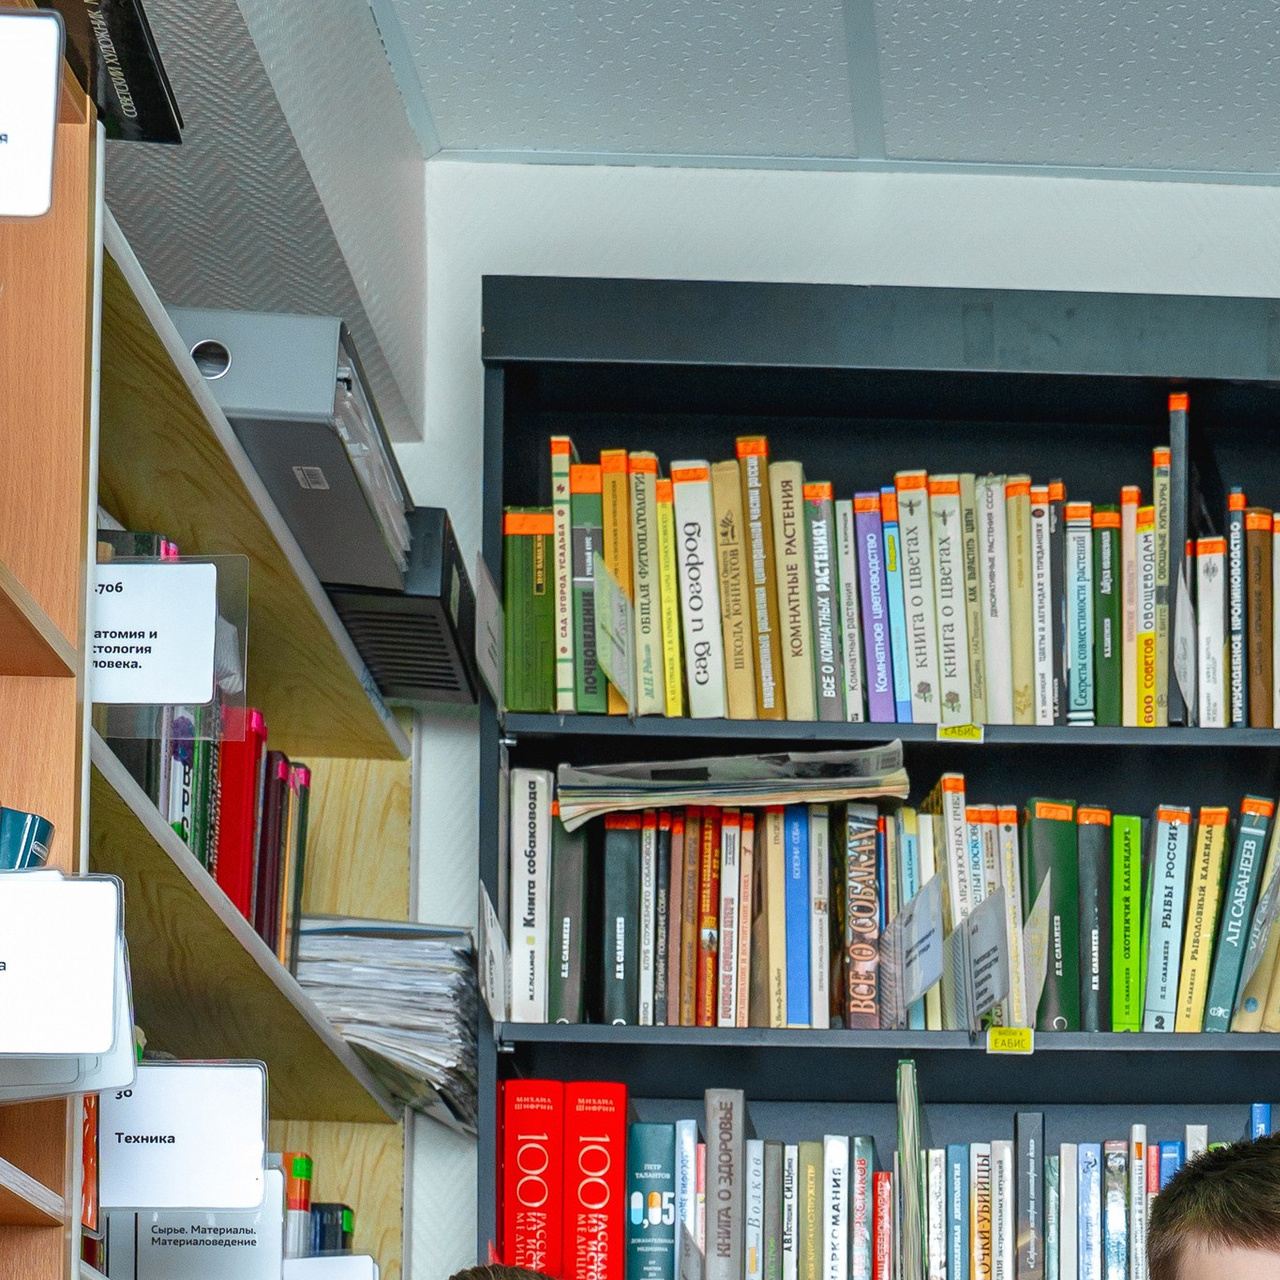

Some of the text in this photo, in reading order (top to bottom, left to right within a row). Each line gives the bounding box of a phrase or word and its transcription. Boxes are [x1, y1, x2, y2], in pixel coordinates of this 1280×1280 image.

[93, 9, 139, 119] СОВЕТСКИЙ ХУДОЖНИК
[780, 479, 804, 658] КОМНАТНЫЕ РАСТЕНИЯ
[1157, 483, 1167, 581] ОВОЩНЫЕ КУЛЬТУРЫ
[584, 590, 598, 696] ПОЧВОВЕДЕНИЕ
[730, 548, 744, 670] ШКОЛА ЮННАТОВ
[814, 520, 836, 698] ВСЕ О КОМНАТНЫХ РАСТЕНИЯХ
[845, 582, 858, 692] Комнатные растения
[1073, 536, 1088, 707] Секреты совместимости растений
[1143, 533, 1154, 724] 600 СОВЕТОВ ОВОЩЕВОДАМ
[1230, 521, 1245, 723] ПРИУСАДЕБНОЕ КРОЛИКОВОДСТВО
[523, 780, 537, 929] Книга собаковода
[1121, 829, 1131, 960] ОХОТНИЧИЙ КАЛЕНДАРЬ
[1162, 887, 1174, 929] РЫБЫ
[1225, 839, 1257, 947] Л.П. САБАНЕЕВ
[848, 817, 878, 1014] ВСЕ О СОБАКАХ
[993, 1039, 1026, 1049] ЕАБИС
[1154, 1016, 1165, 1030] 2
[115, 1132, 175, 1145] Техника
[516, 1132, 549, 1208] 100
[577, 1134, 611, 1211] 100
[634, 1172, 671, 1180] ТАЛАНТОВ
[716, 1101, 734, 1259] КНИГА О ЗДОРОВЬЕ
[746, 1157, 762, 1229] Волков
[151, 1224, 257, 1236] Сырье. Материалы.
[151, 1236, 257, 1247] Материаловедение
[976, 1152, 992, 1277] ОЧКИ-УБИЙЦЫ
